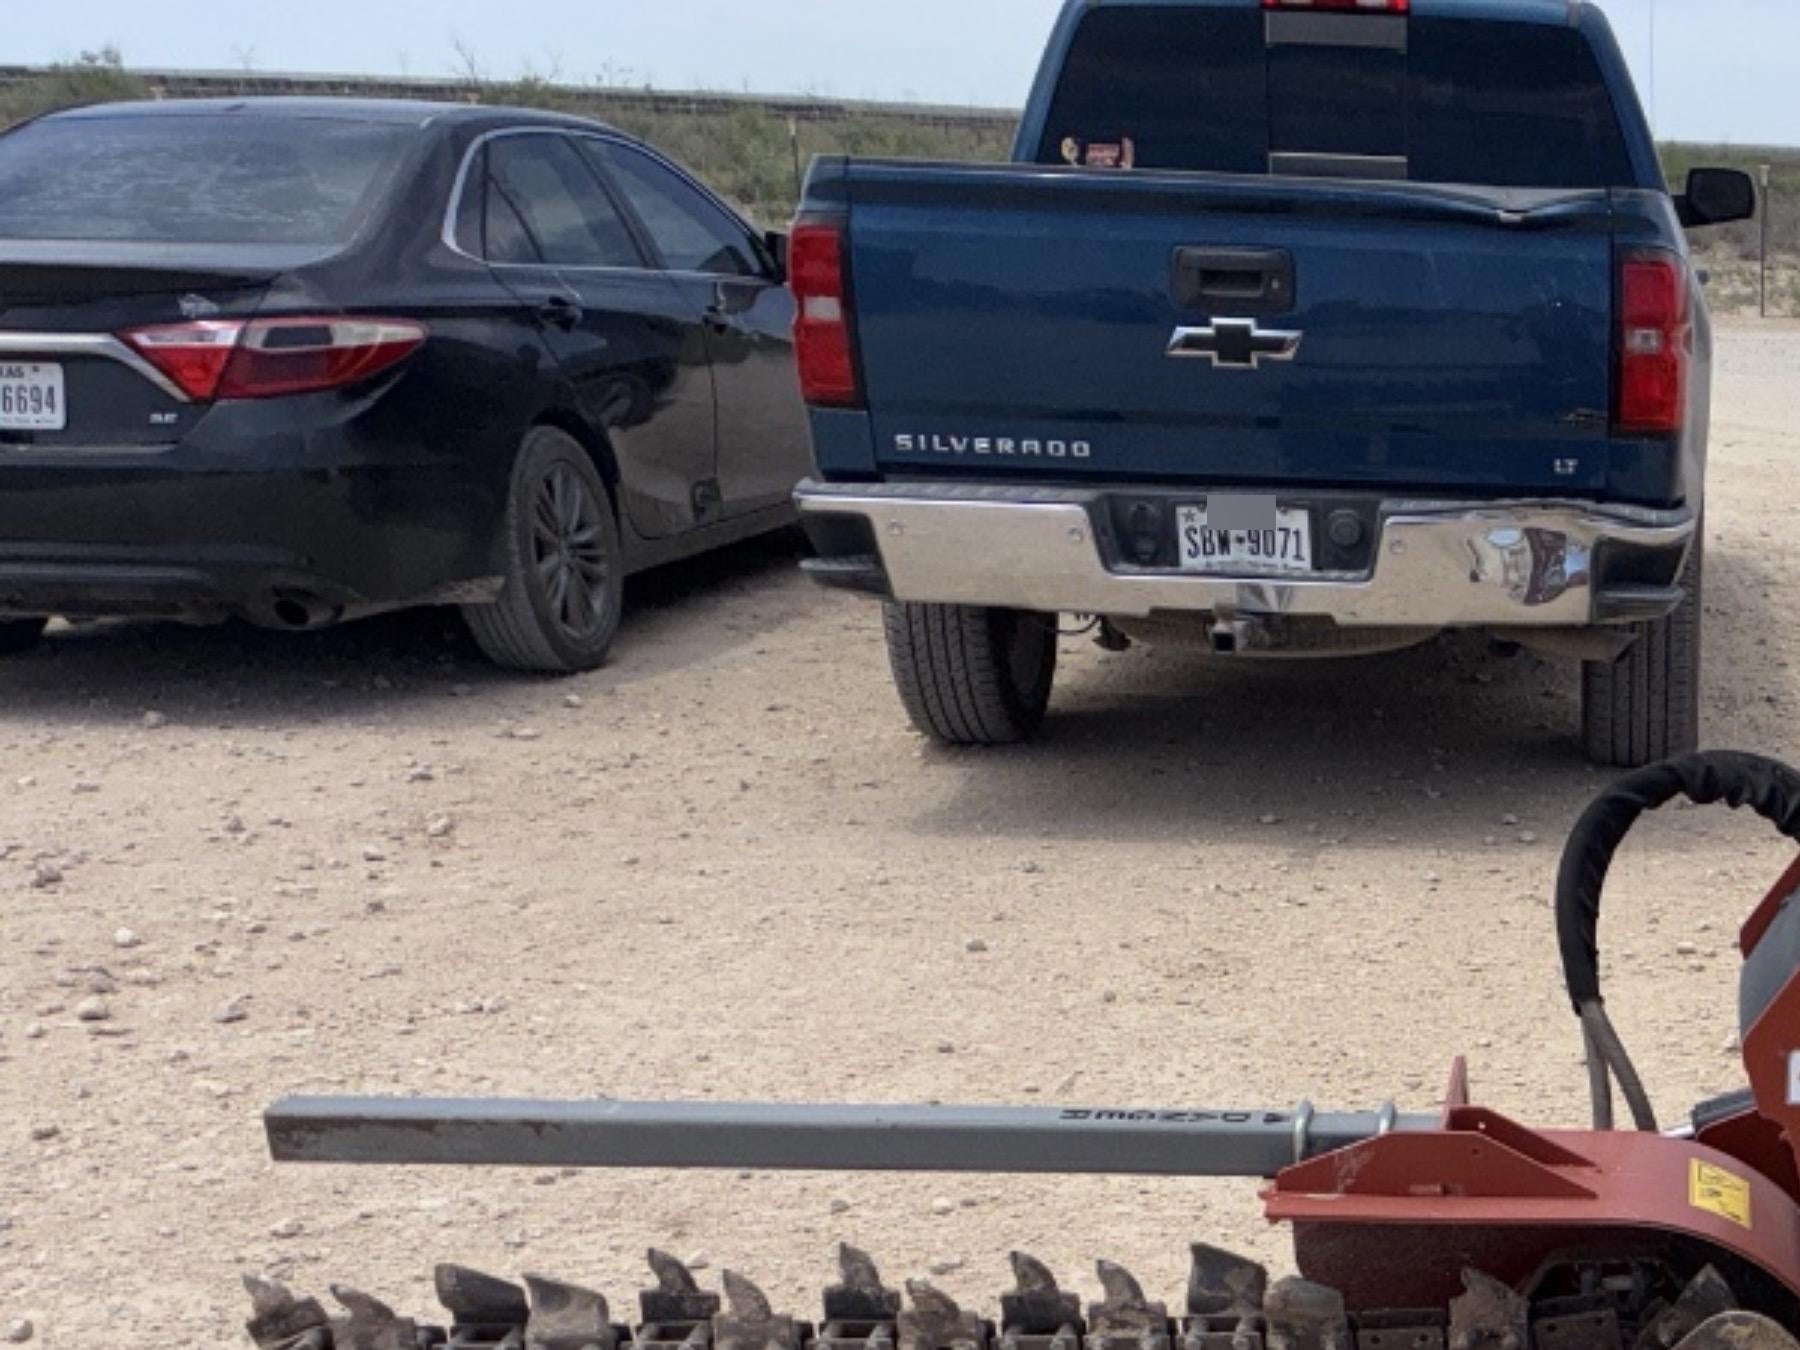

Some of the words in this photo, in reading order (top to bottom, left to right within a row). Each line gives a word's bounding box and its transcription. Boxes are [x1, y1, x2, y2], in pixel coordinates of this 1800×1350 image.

[2, 384, 55, 415] 6694
[894, 434, 1091, 458] SILVERADO
[1552, 458, 1579, 475] LT
